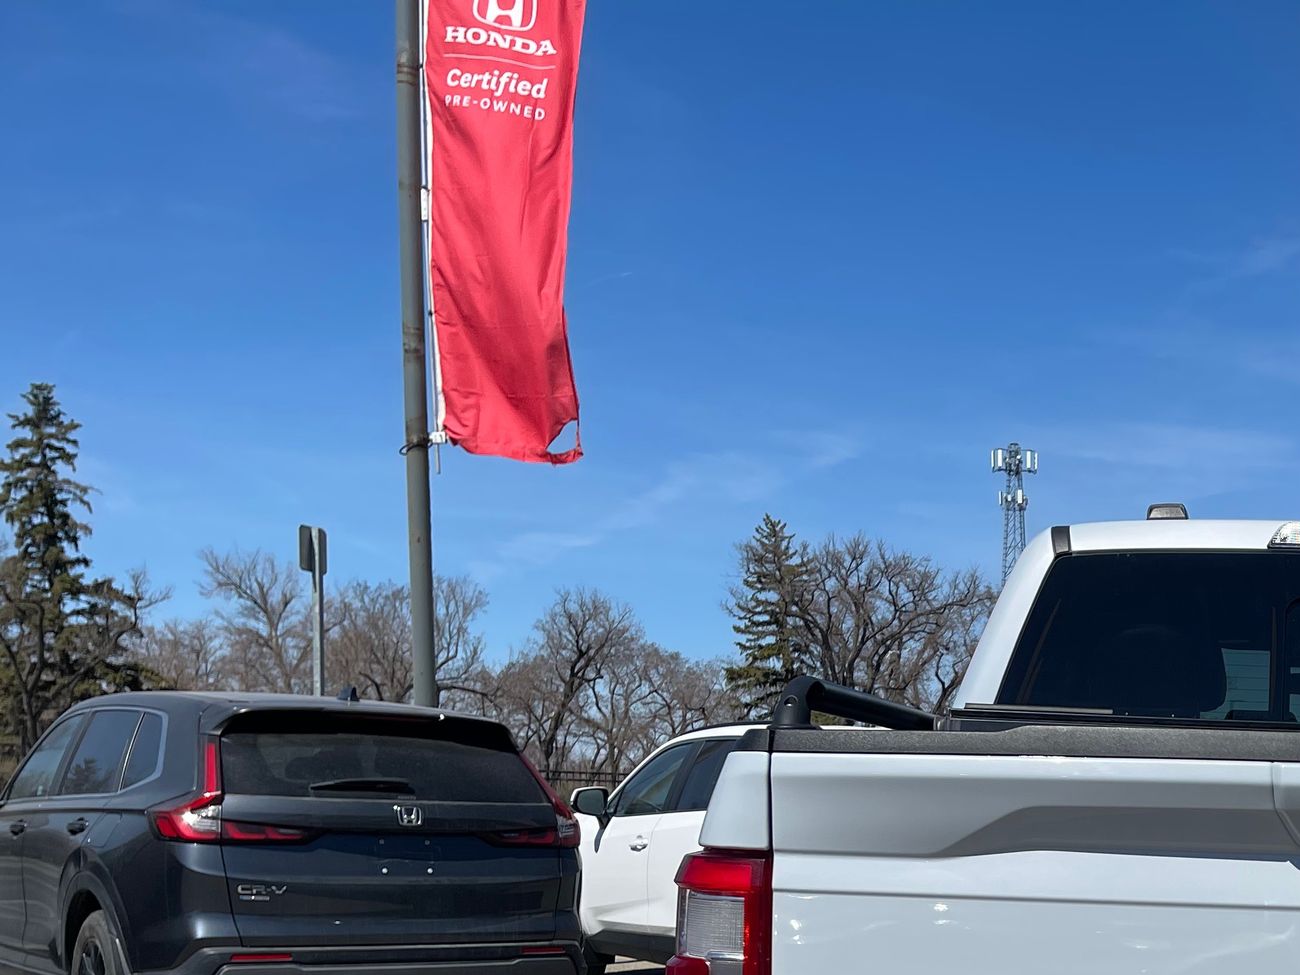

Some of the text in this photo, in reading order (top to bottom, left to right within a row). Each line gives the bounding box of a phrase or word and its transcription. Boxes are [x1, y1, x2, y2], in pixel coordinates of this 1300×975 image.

[444, 26, 557, 56] HONDA
[446, 68, 548, 99] Certified
[444, 94, 546, 121] PRE-OWNED
[237, 885, 288, 895] CR-V
